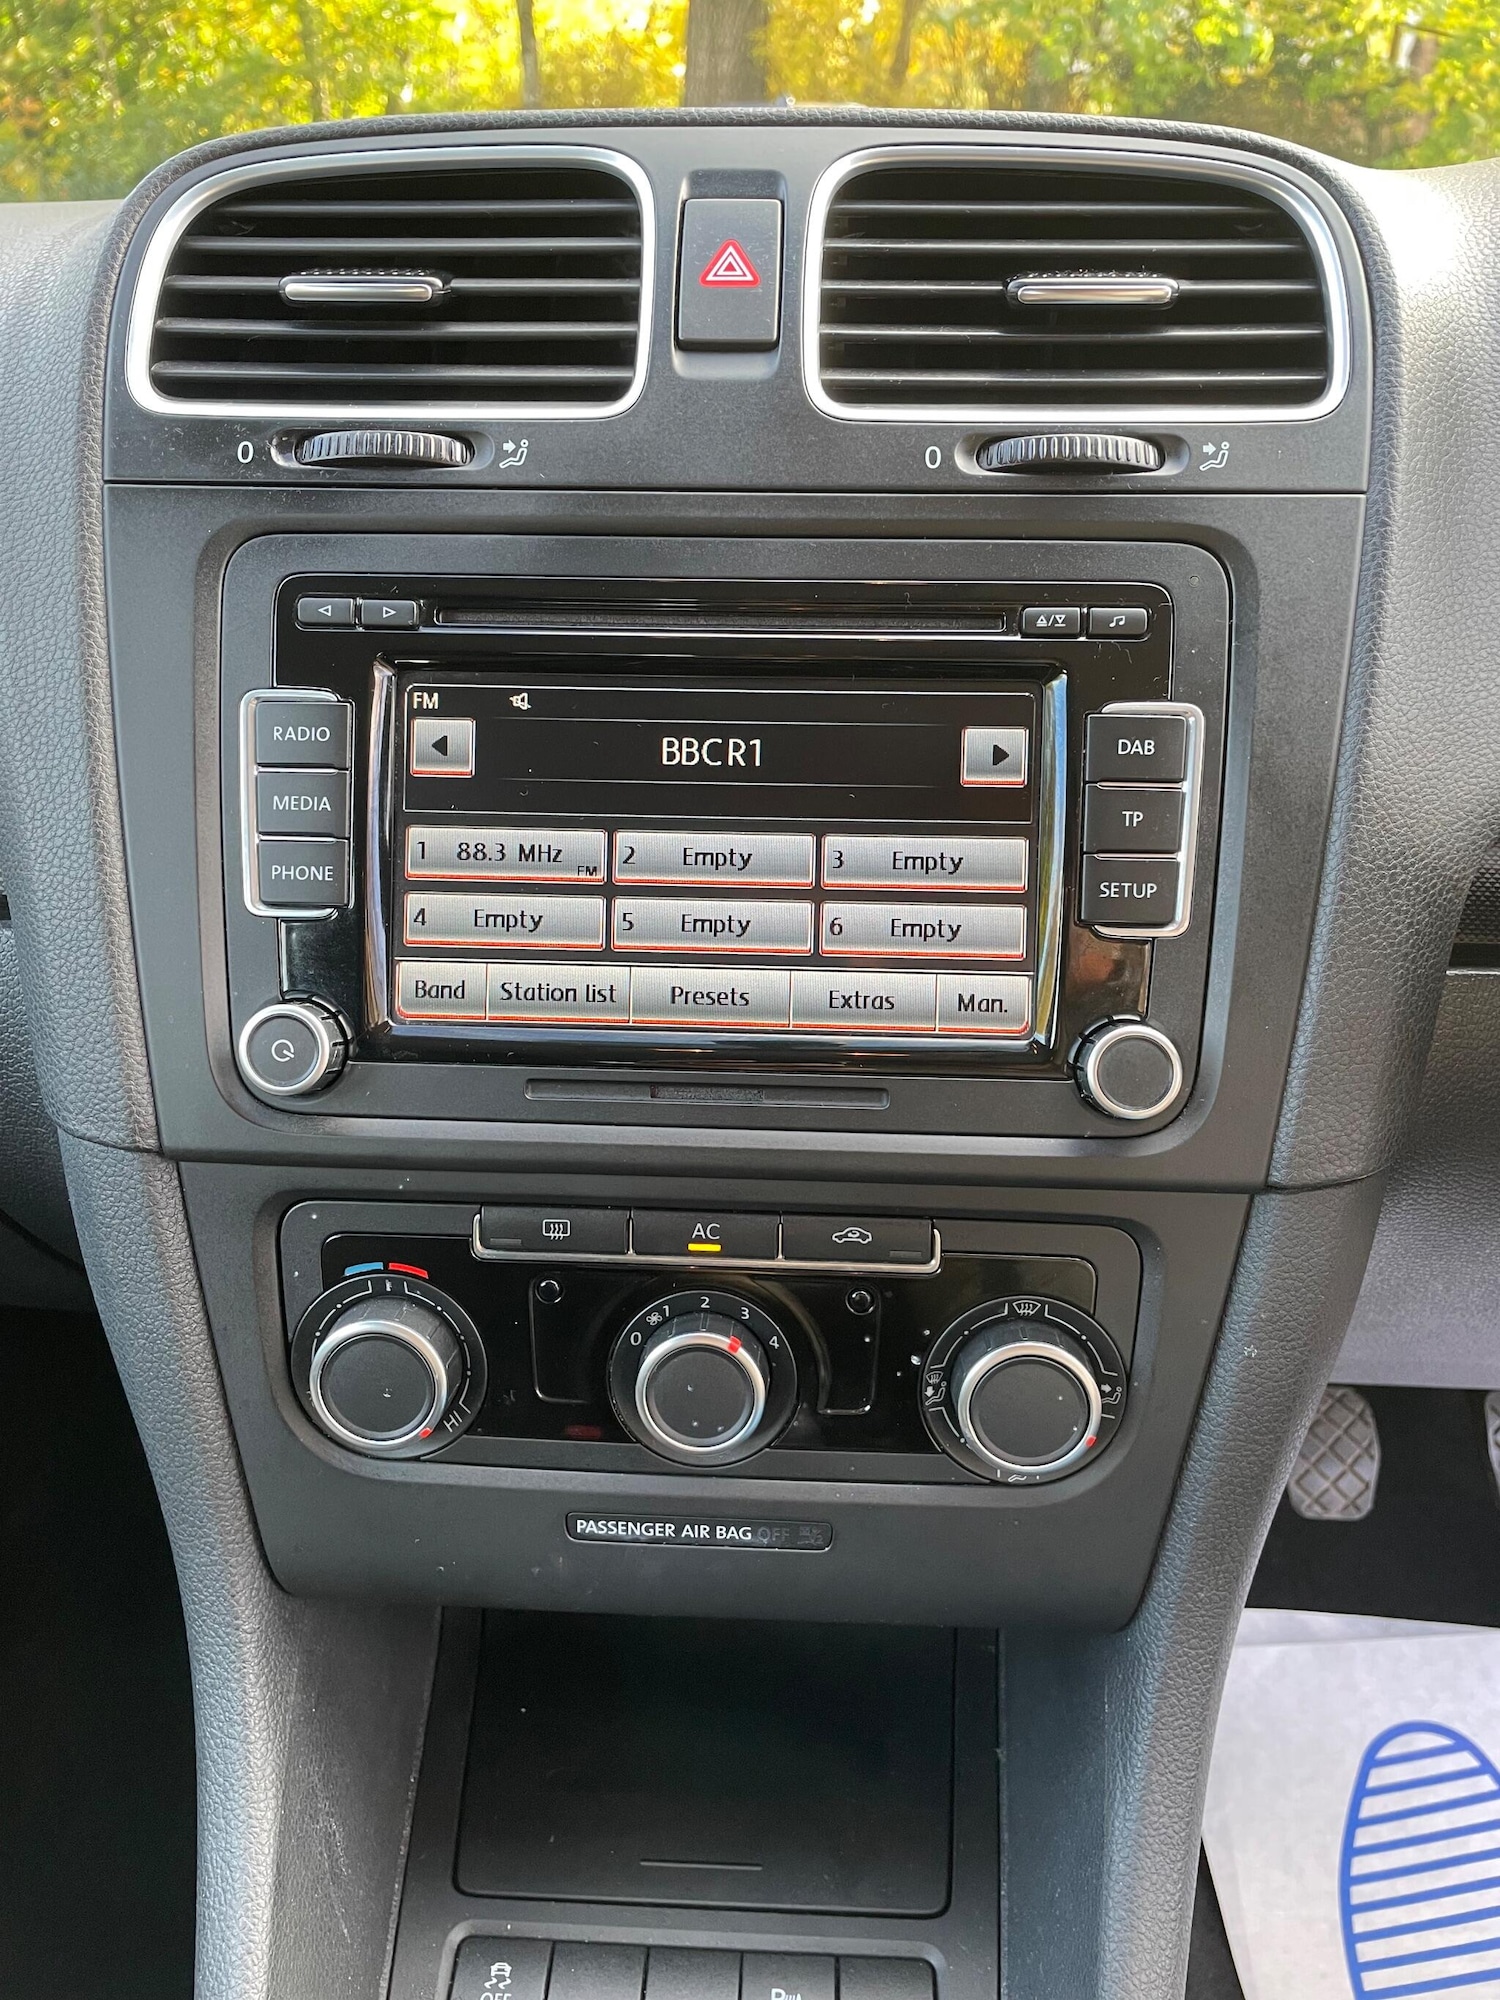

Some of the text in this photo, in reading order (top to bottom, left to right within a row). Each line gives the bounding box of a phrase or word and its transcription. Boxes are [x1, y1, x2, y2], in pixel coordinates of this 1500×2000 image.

[237, 440, 254, 464] 0
[925, 445, 942, 469] 0
[412, 692, 439, 710] FM
[273, 726, 331, 742] RADIO
[661, 736, 762, 768] BBCR1
[1117, 739, 1155, 756] DAB
[272, 795, 332, 812] MEDIA
[1122, 811, 1144, 828] TP
[416, 841, 563, 864] 1 88.3 MHz
[622, 845, 753, 872] 2 Empty
[576, 865, 598, 877] FM
[832, 850, 964, 876] 3 Empty
[271, 865, 335, 882] PHONE
[1099, 882, 1158, 899] SETUP
[413, 907, 544, 933] 4 Empty
[622, 912, 751, 938] 5 Empty
[829, 917, 962, 943] 6 Empty
[414, 979, 466, 1000] Band
[500, 981, 617, 1004] Station list
[670, 986, 750, 1006] Presets
[828, 990, 896, 1011] Extras
[957, 994, 1009, 1014] Man.
[691, 1222, 721, 1240] AC
[662, 1305, 671, 1317] 1
[700, 1296, 711, 1309] 2
[740, 1306, 750, 1320] 3
[630, 1331, 642, 1346] 0
[768, 1335, 780, 1350] 4
[576, 1519, 790, 1543] PASSENGER AIR BAG OFF
